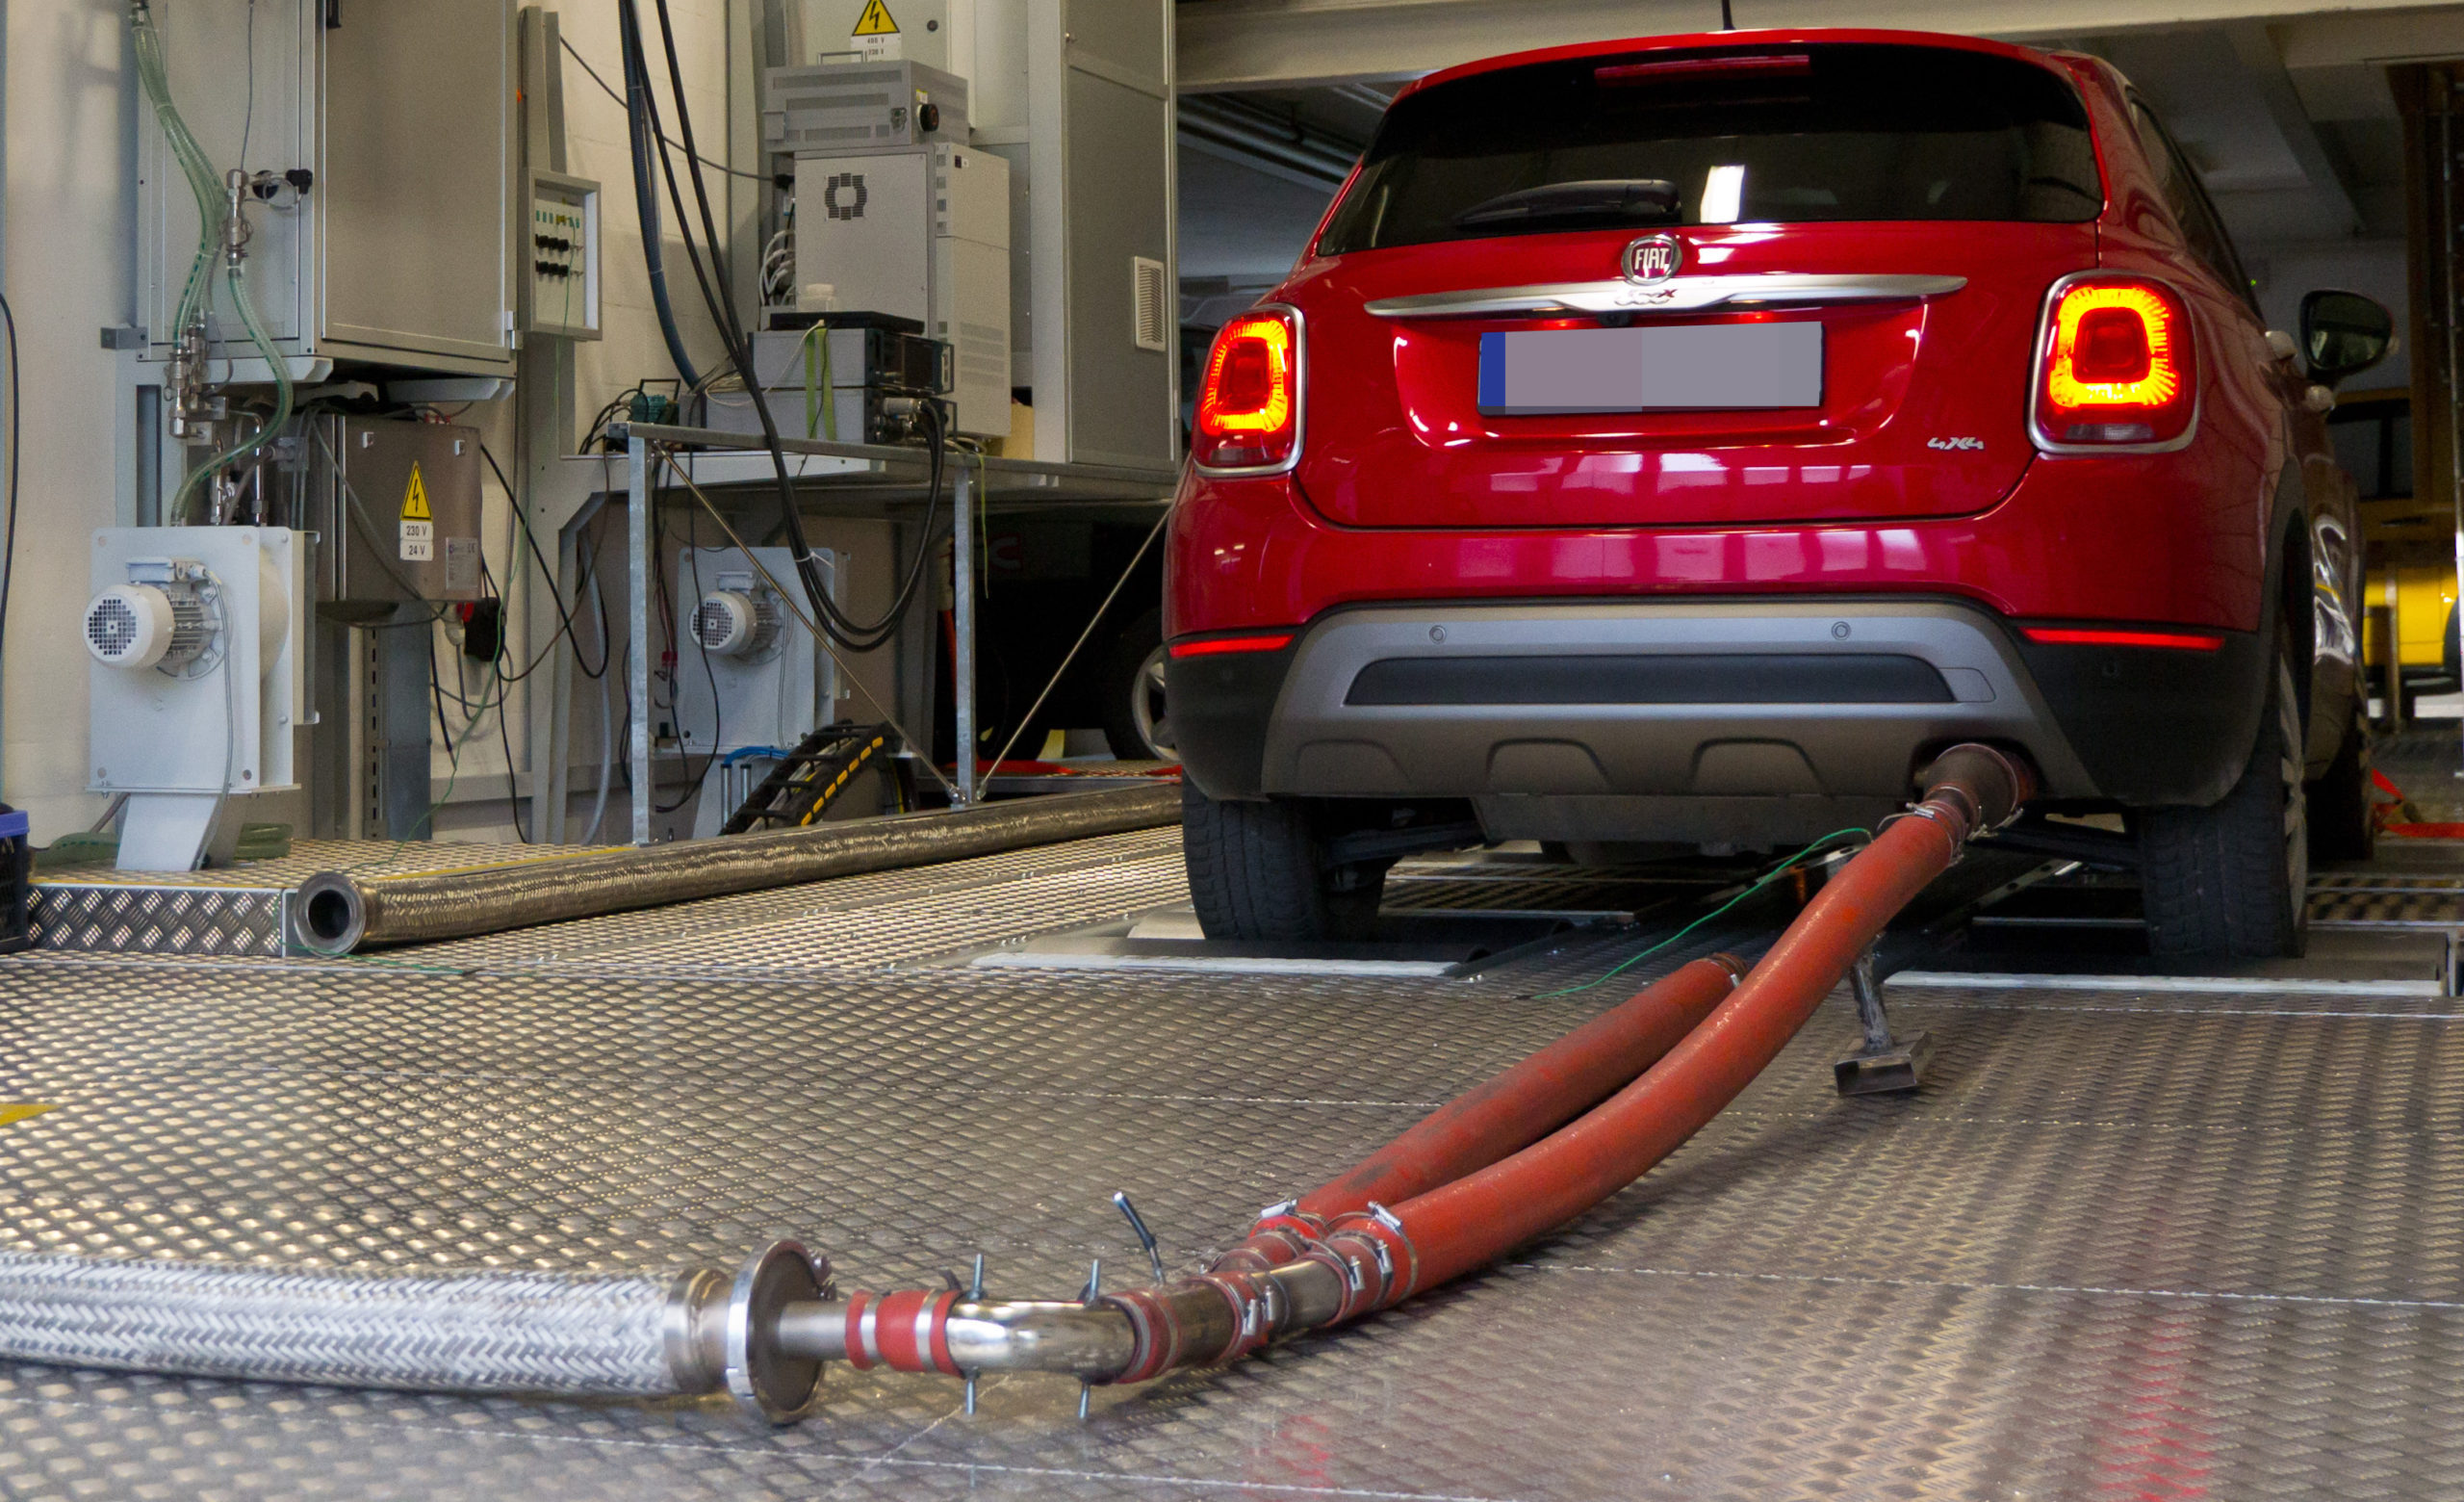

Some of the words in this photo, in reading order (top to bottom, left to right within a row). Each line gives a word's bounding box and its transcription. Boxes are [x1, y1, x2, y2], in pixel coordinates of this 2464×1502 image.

[1634, 247, 1670, 271] FIAT
[406, 525, 420, 536] 230
[422, 525, 427, 536] V
[408, 545, 418, 556] 24
[420, 545, 425, 556] V
